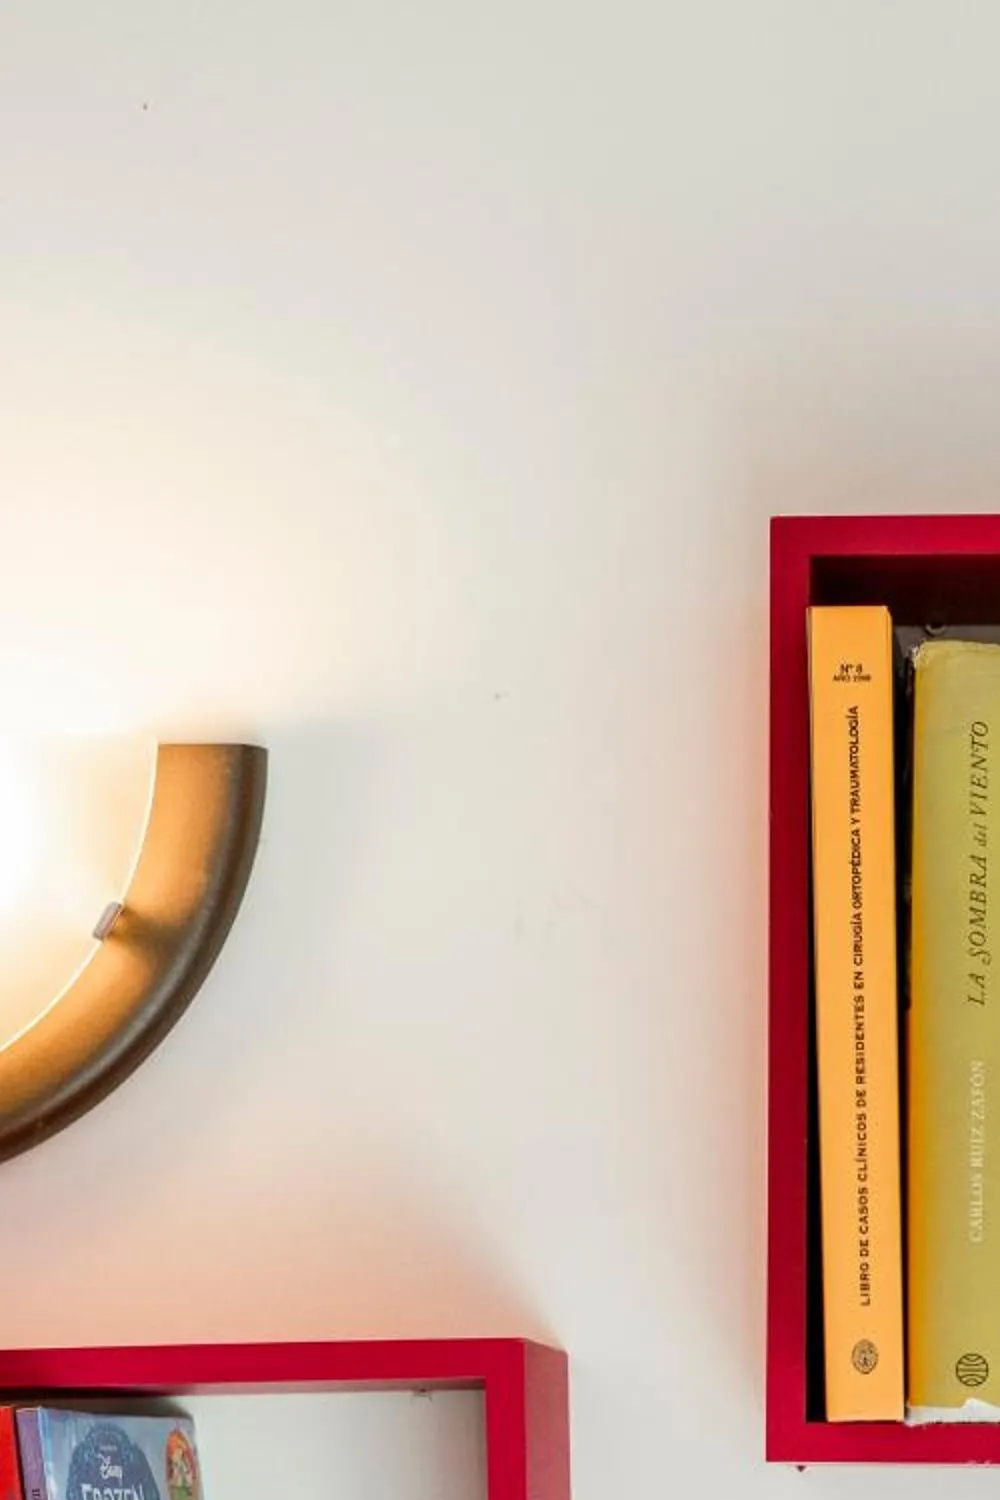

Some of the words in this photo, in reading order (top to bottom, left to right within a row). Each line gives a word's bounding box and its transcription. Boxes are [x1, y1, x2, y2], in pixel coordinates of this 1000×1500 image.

[969, 721, 990, 816] VIENTO
[850, 817, 861, 825] Y
[971, 823, 990, 847] del
[967, 854, 992, 965] SOMBRA
[854, 971, 865, 990] EN
[967, 973, 986, 1006] LA
[854, 996, 866, 1084] RESIDENTES
[856, 1090, 867, 1107] DE
[854, 1113, 868, 1182] CLÍNICOS
[857, 1187, 869, 1235] CASOS
[859, 1239, 870, 1257] DE
[860, 1262, 871, 1307] LIBRO
